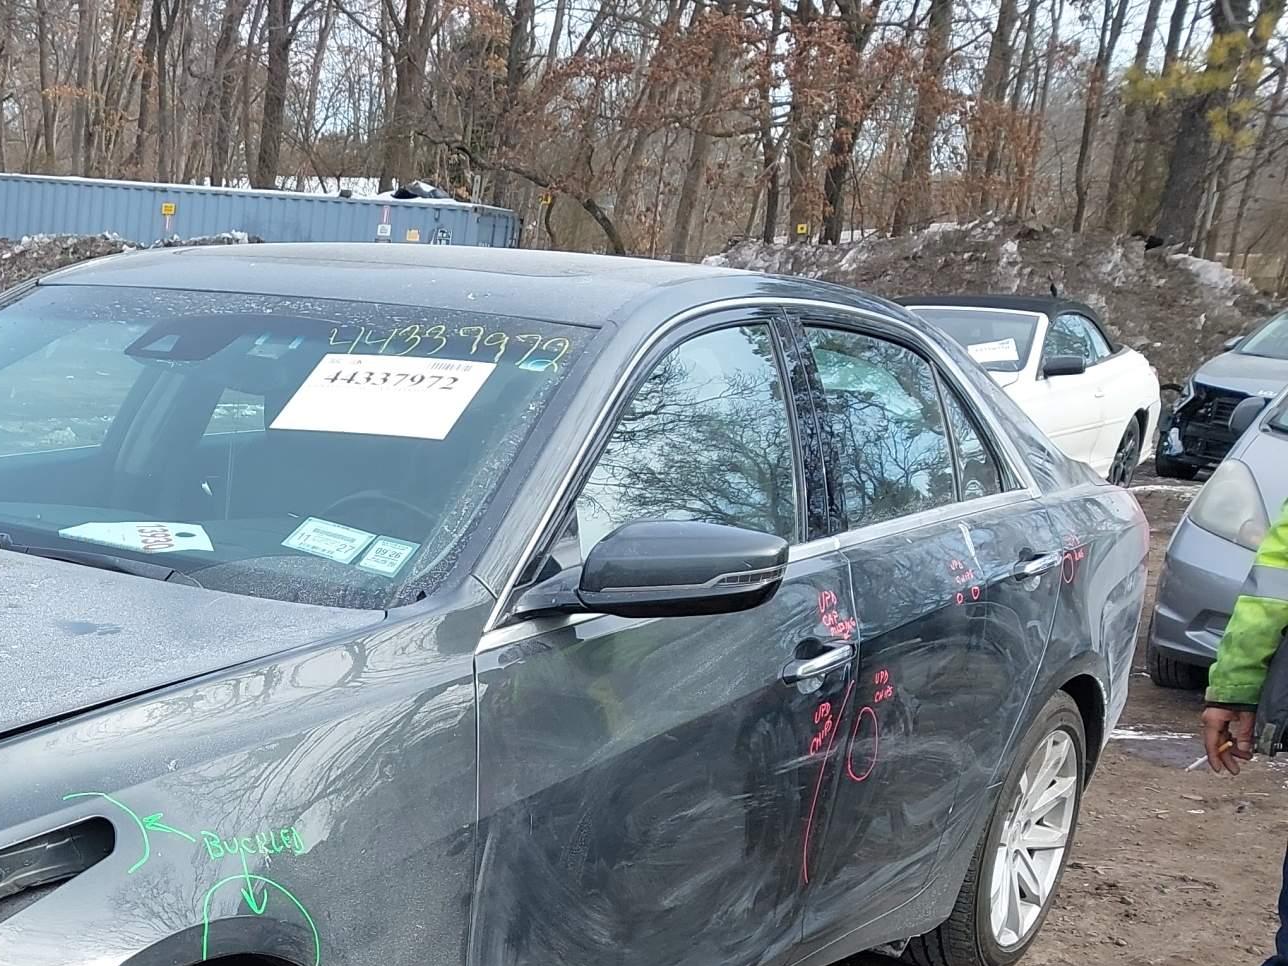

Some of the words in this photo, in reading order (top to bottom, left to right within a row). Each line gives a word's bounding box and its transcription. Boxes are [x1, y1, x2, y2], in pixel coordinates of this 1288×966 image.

[328, 324, 569, 373] 44337972
[324, 370, 459, 391] 44337972
[136, 523, 175, 551] 13930
